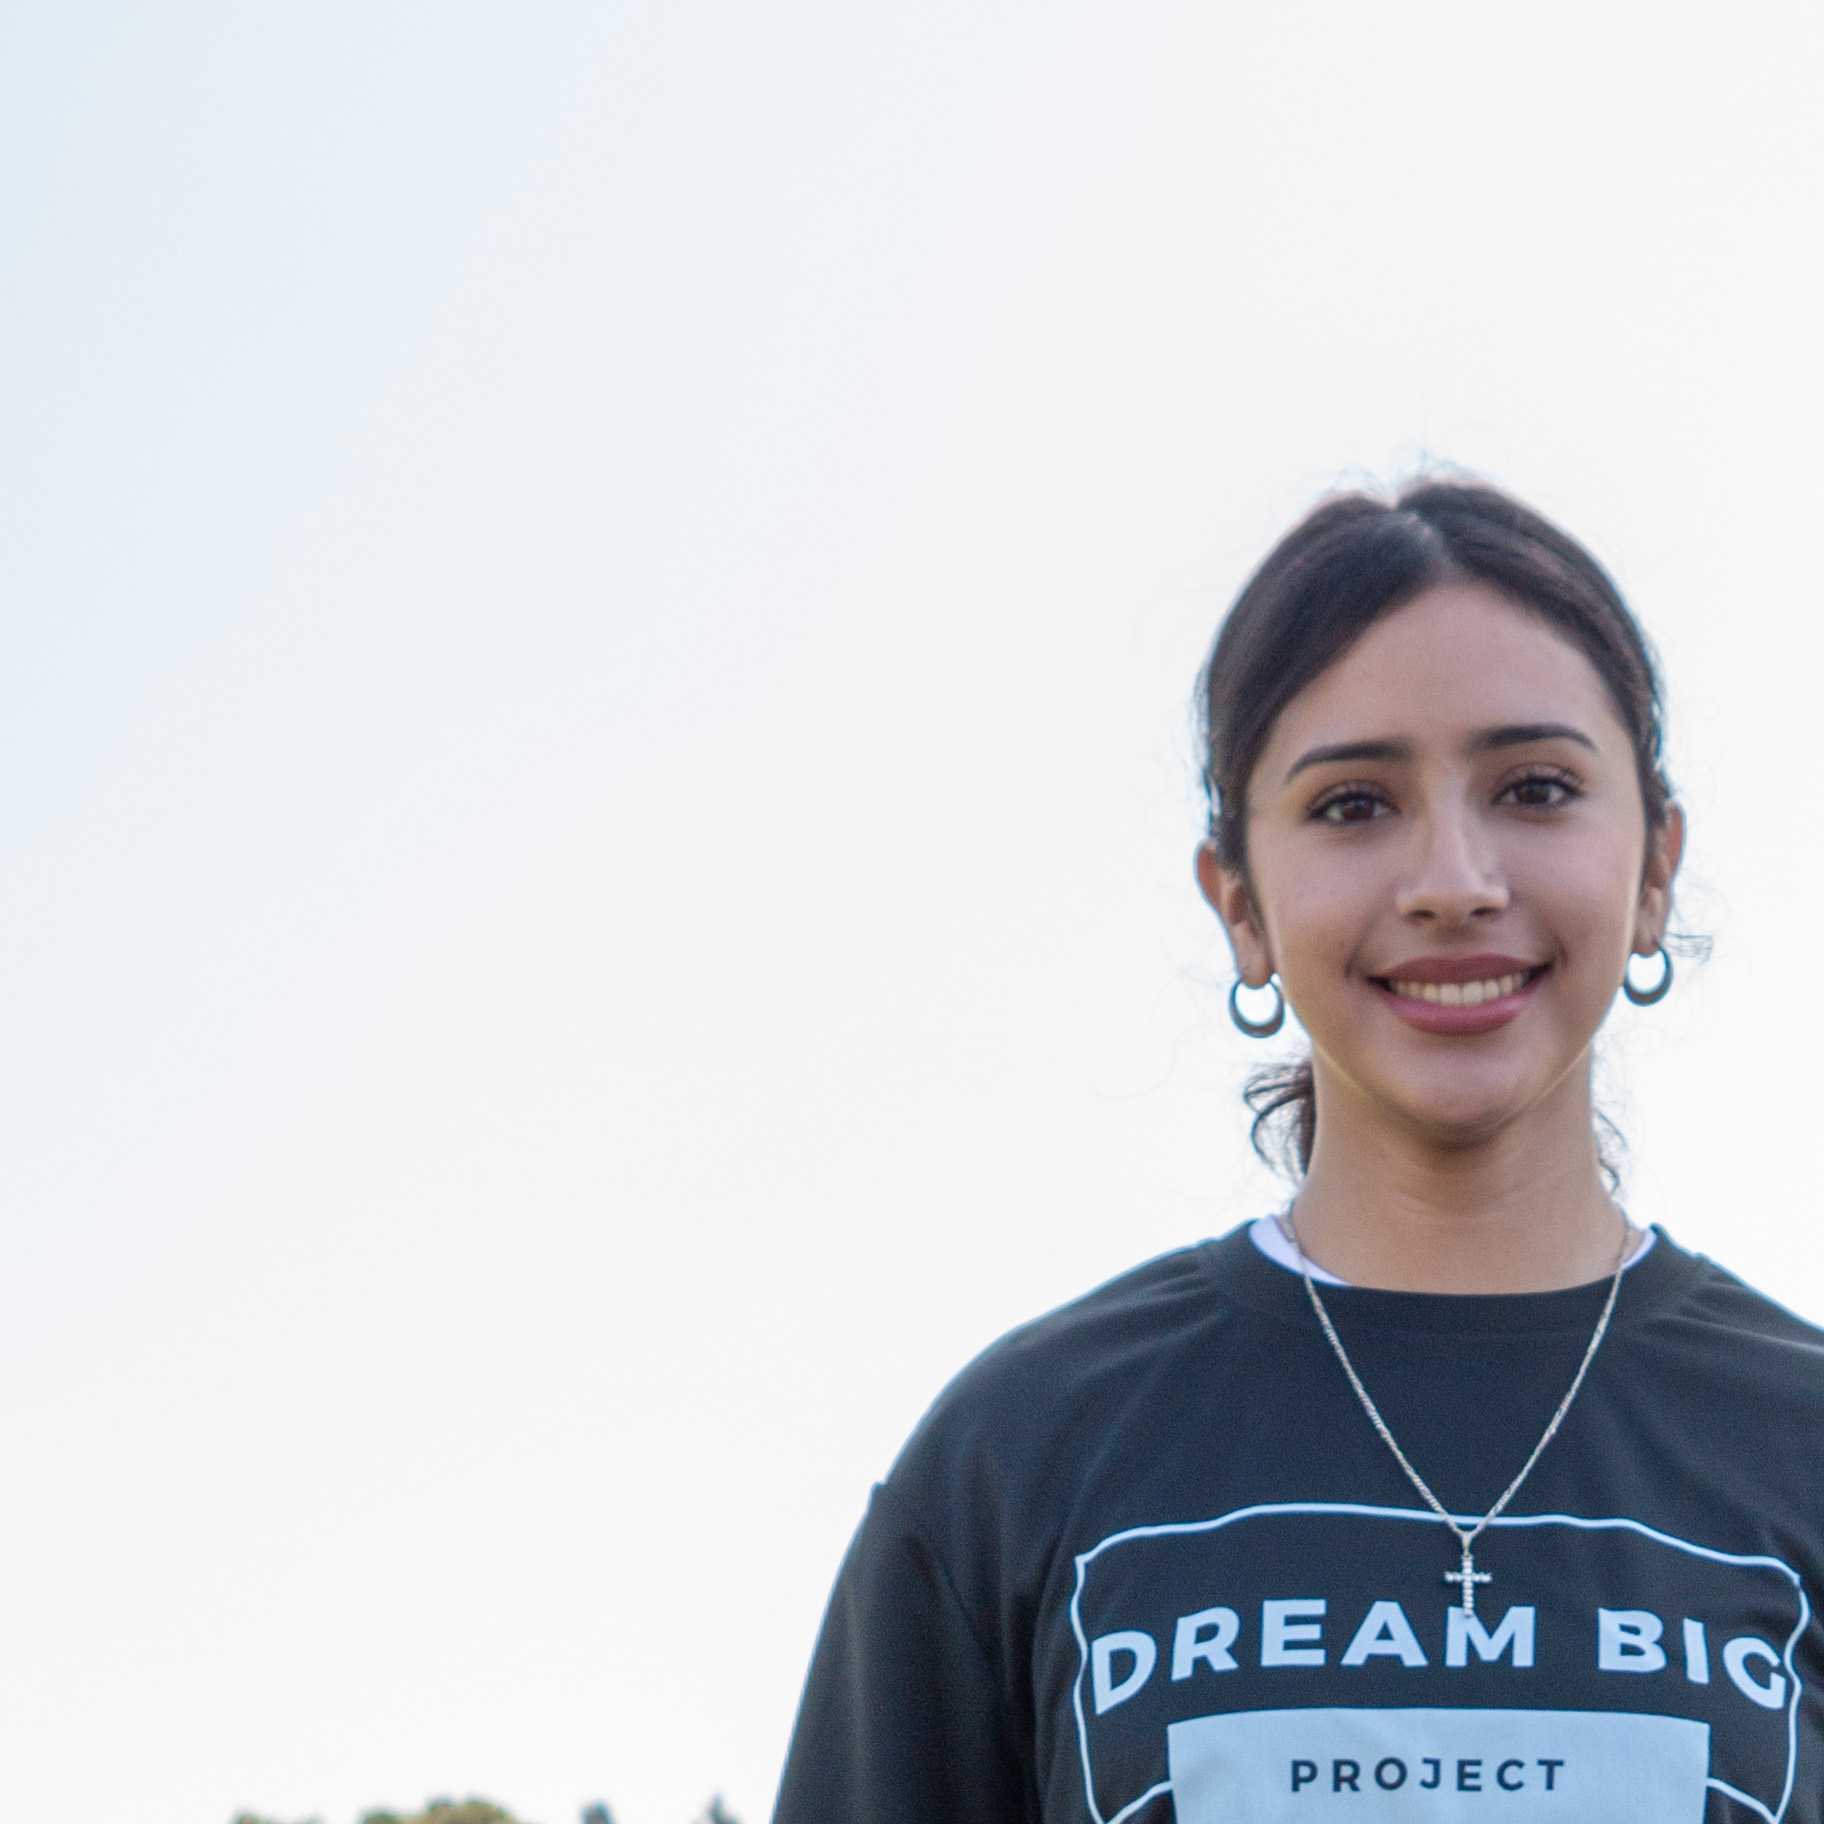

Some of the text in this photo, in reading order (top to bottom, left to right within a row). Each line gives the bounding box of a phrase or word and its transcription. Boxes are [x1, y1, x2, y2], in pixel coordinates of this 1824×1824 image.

[1091, 1599, 1786, 1716] DREAM BIG
[1291, 1758, 1566, 1793] PROJECT
